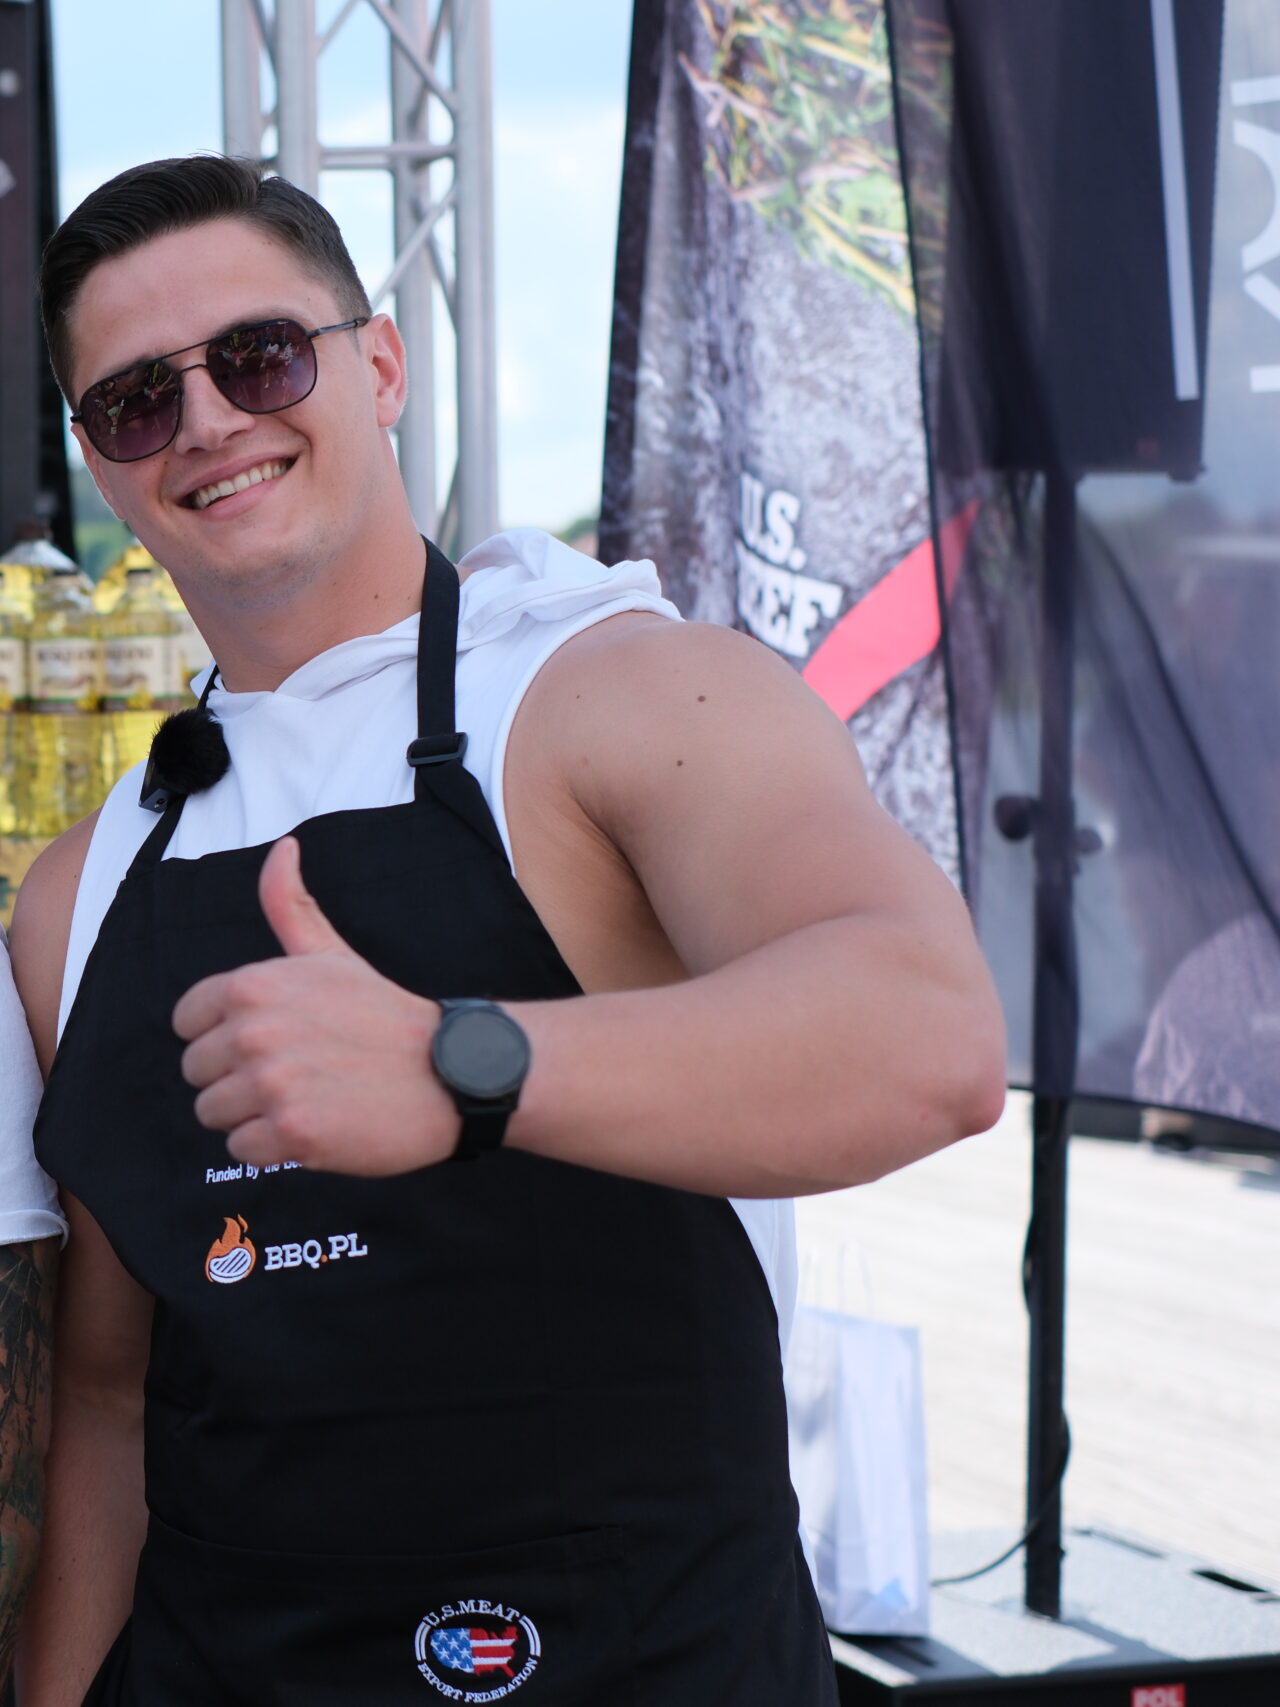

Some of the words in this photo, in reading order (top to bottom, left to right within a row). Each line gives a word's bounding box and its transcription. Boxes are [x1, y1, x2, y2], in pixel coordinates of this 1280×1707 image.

[740, 471, 807, 572] U.S.
[735, 538, 844, 659] EEF
[206, 1163, 243, 1184] Funded
[246, 1162, 260, 1180] by
[264, 1233, 368, 1271] BBQ.PL
[417, 1662, 463, 1701] EXPORT
[464, 1656, 538, 1704] FEDERATION
